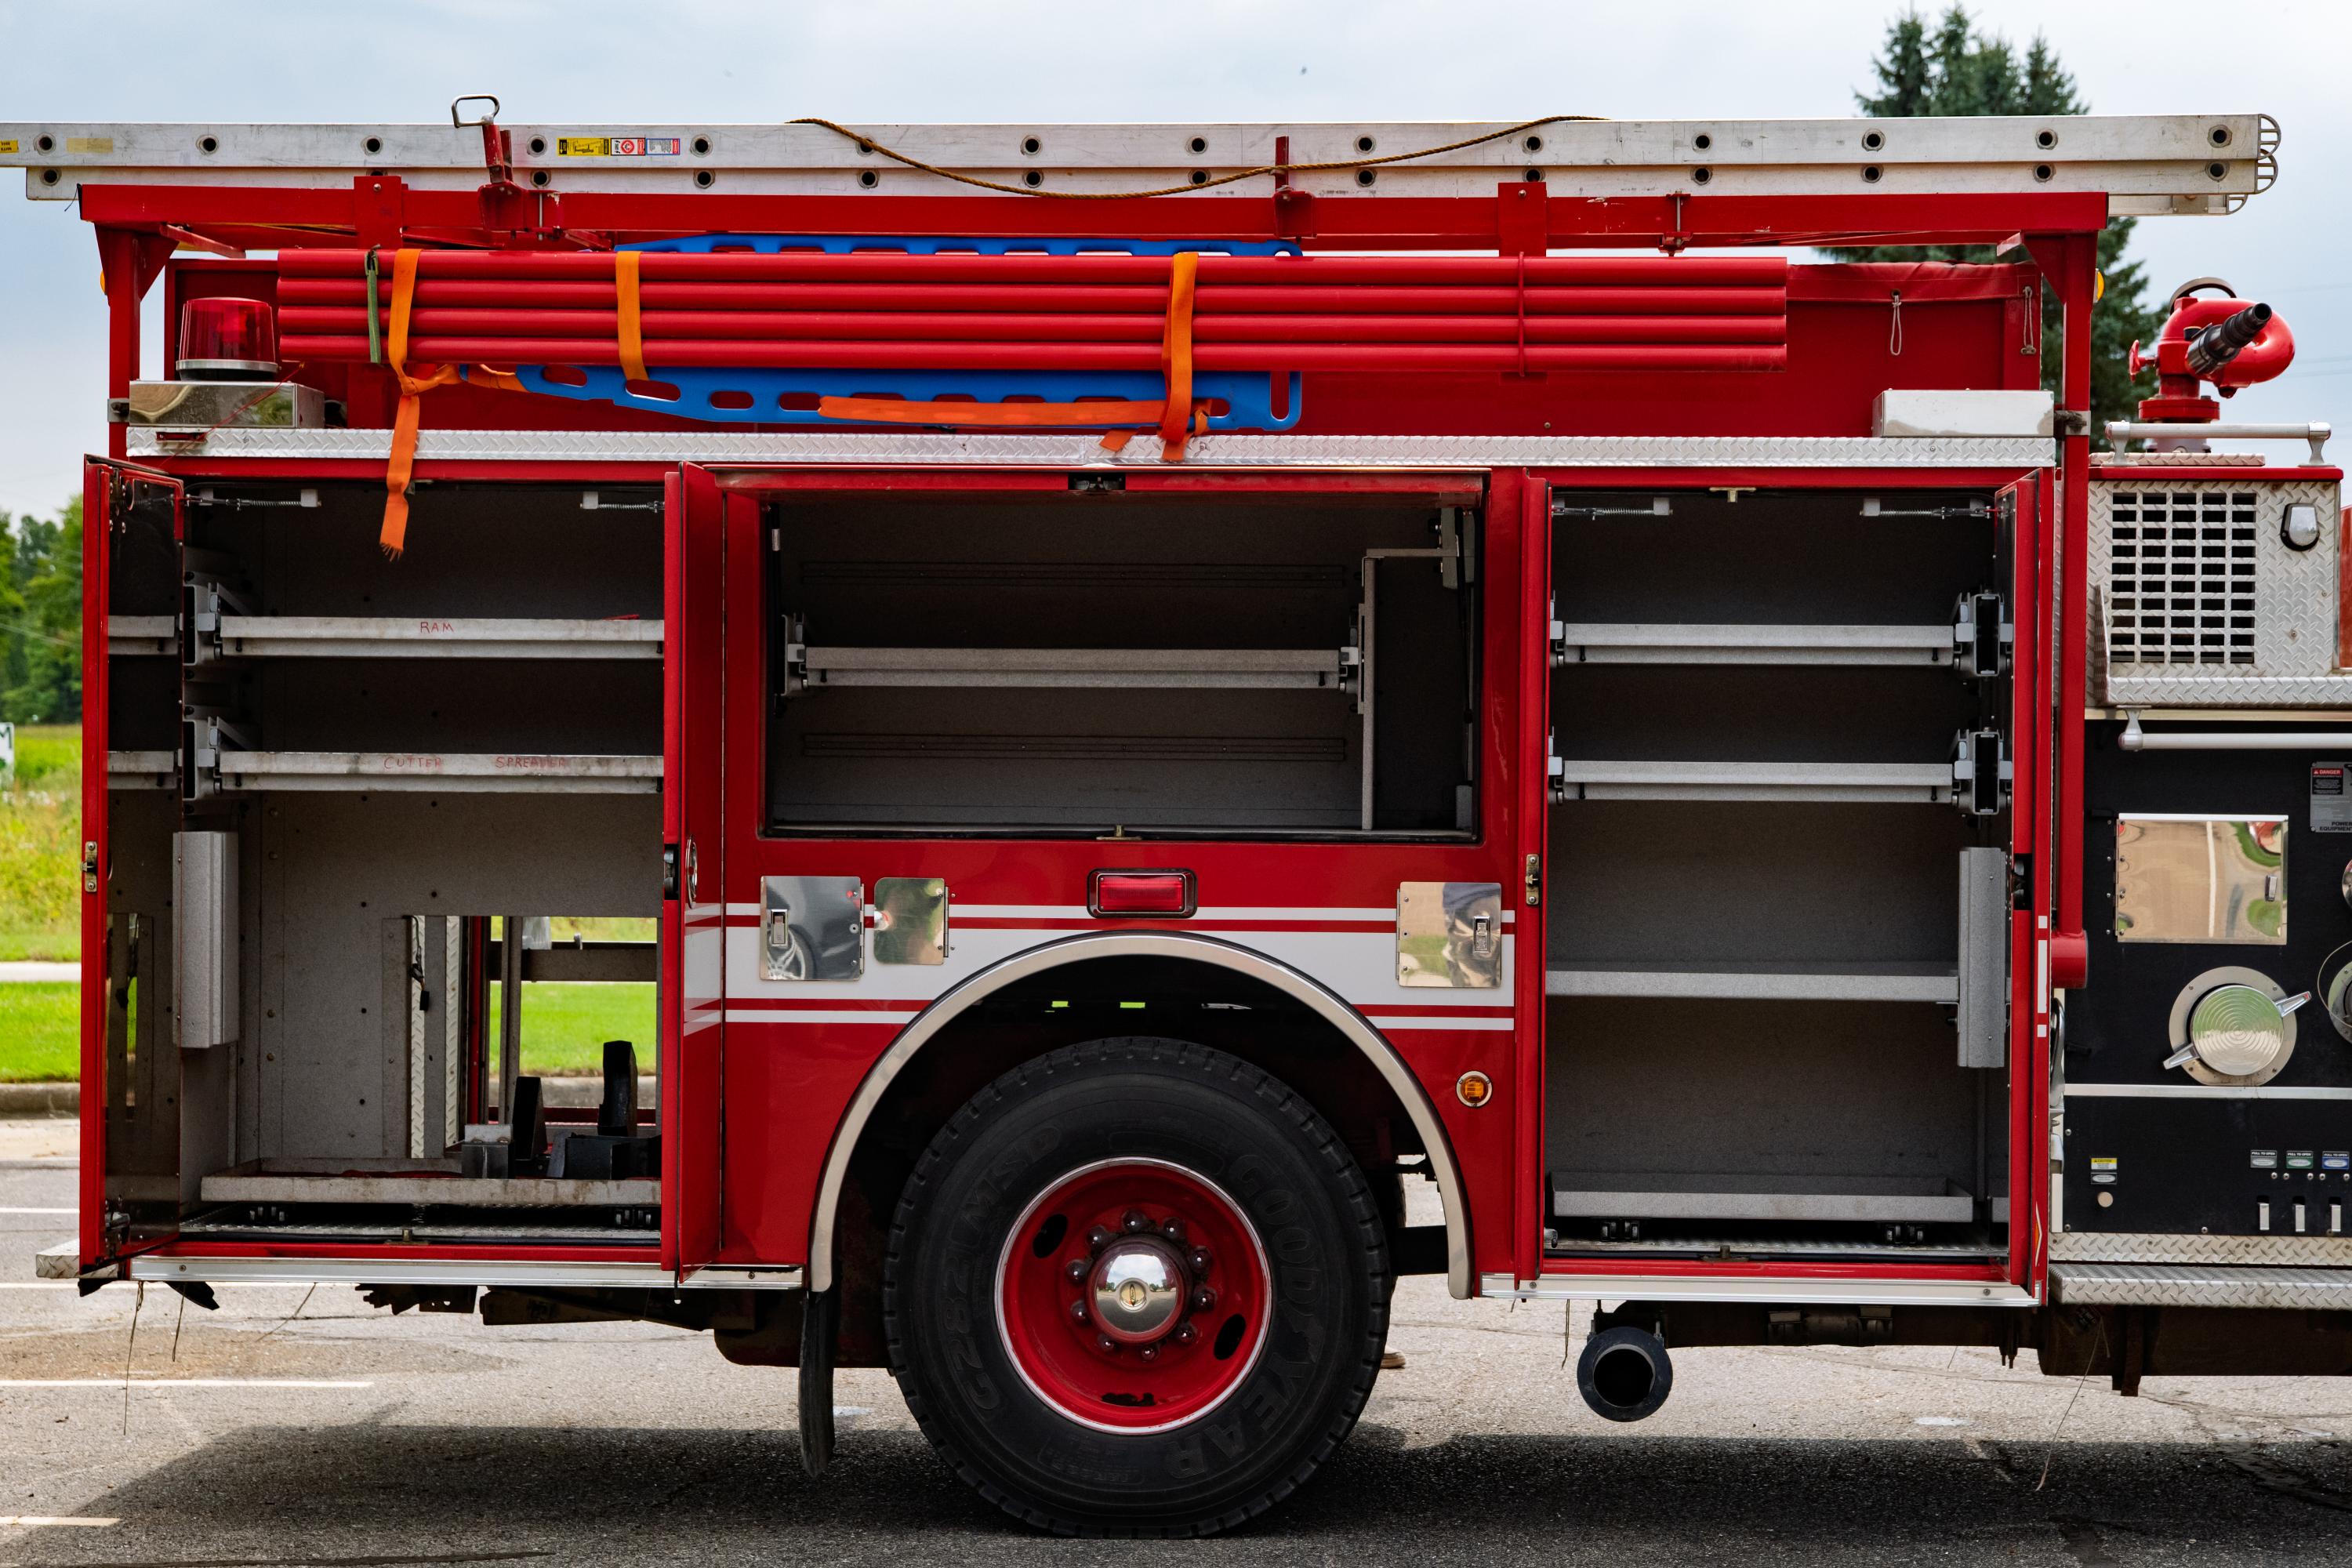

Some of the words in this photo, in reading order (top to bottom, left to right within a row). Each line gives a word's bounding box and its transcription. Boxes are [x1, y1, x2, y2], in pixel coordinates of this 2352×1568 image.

[420, 622, 454, 633] RAM
[384, 757, 441, 768] CUTTER
[495, 756, 566, 768] SPREADER
[1163, 1154, 1322, 1480] GOODYEAR
